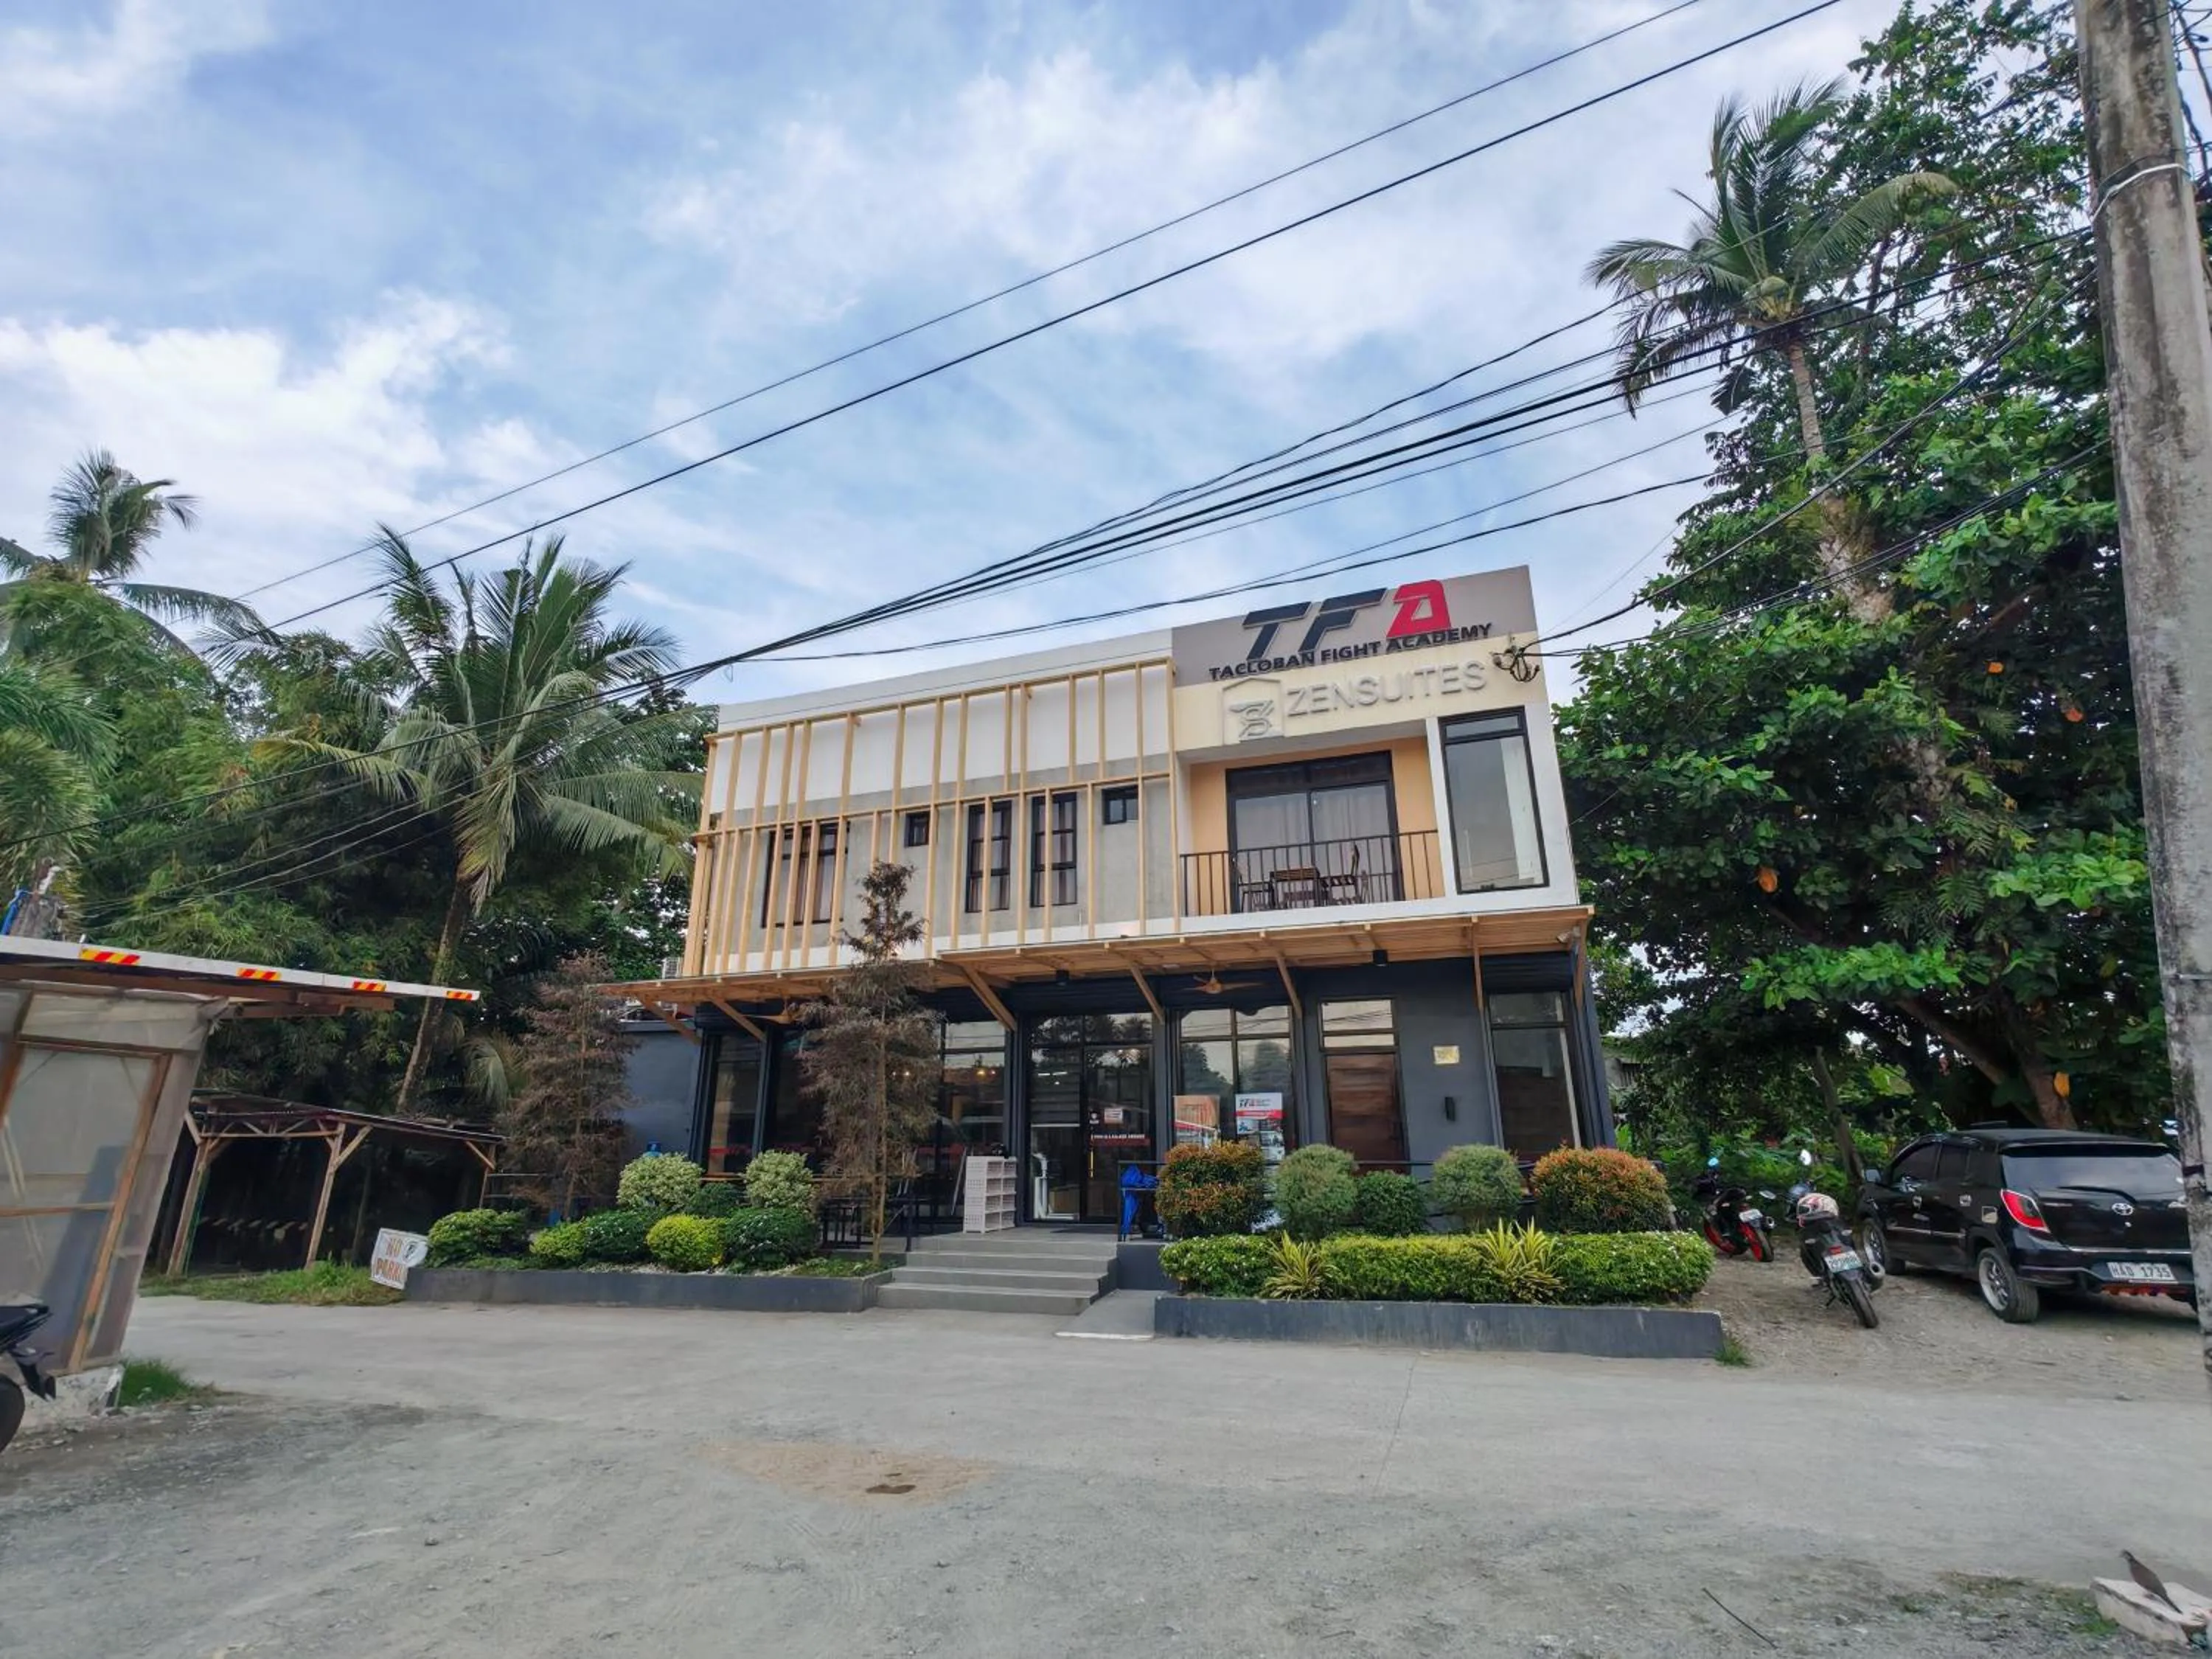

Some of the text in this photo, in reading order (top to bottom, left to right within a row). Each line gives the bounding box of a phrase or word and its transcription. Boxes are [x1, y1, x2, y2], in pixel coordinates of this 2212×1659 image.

[1242, 580, 1452, 660] TFA
[1209, 622, 1492, 681] TACLOBAN FIGHT ACADEMY
[1287, 660, 1487, 717] ZENSUITES
